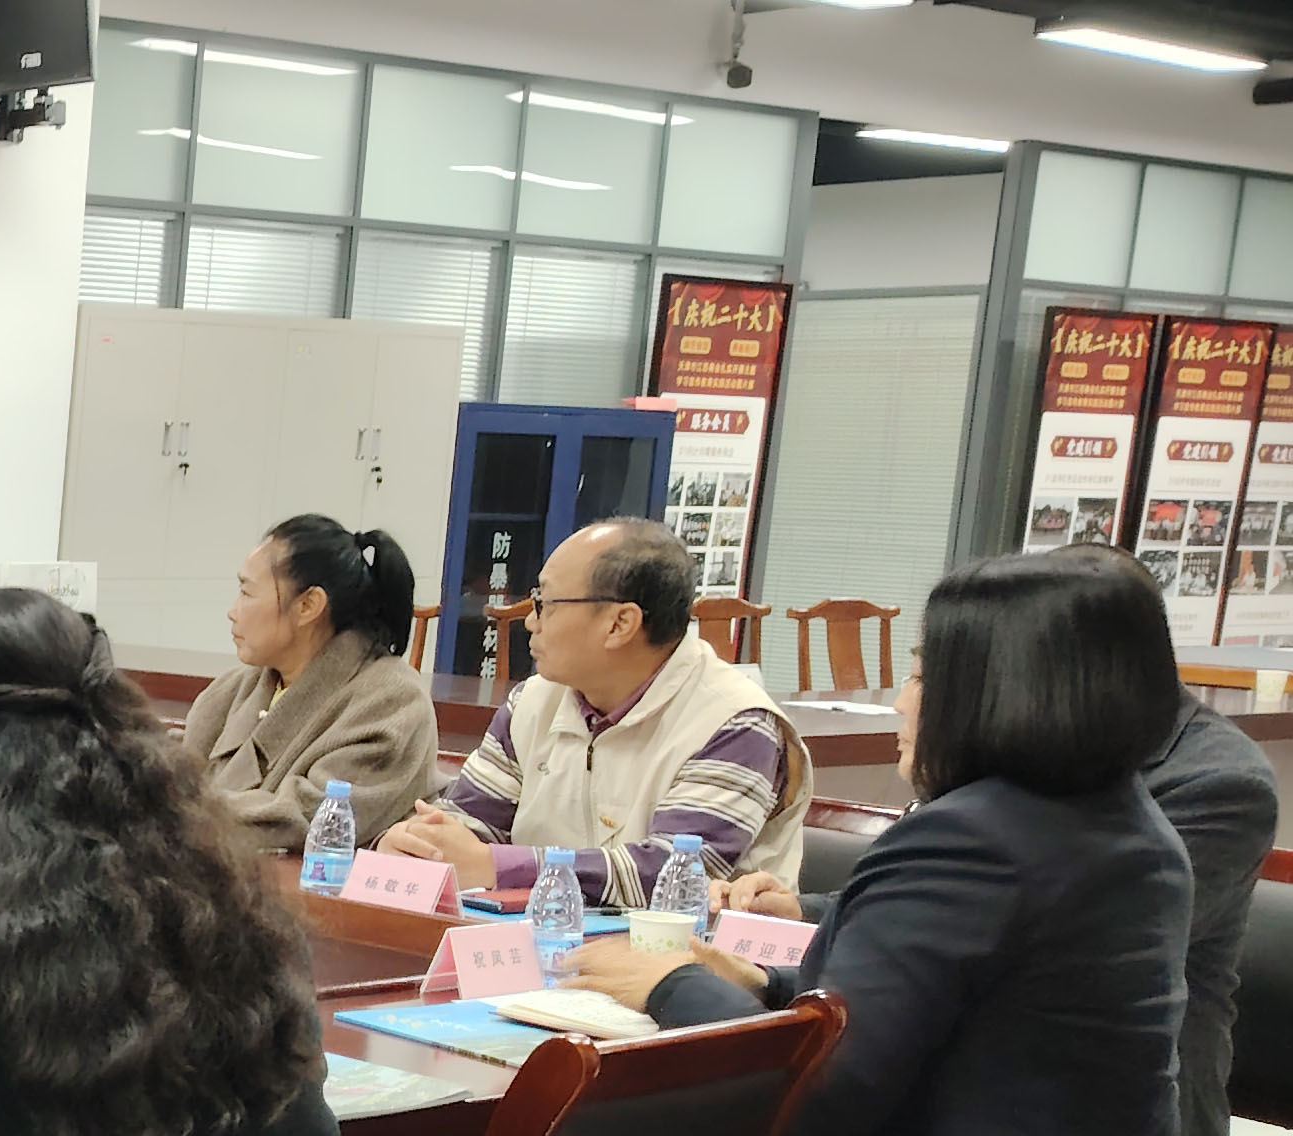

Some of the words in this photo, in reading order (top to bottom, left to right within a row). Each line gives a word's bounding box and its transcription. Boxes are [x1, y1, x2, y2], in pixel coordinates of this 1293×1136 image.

[671, 296, 777, 332] 【庆祝二十大】
[1053, 326, 1146, 359] 【庆祝二十大】
[1170, 334, 1263, 366] 【庆祝二十大】
[364, 875, 421, 897] 杨敬华
[732, 938, 804, 963] 郝迎军
